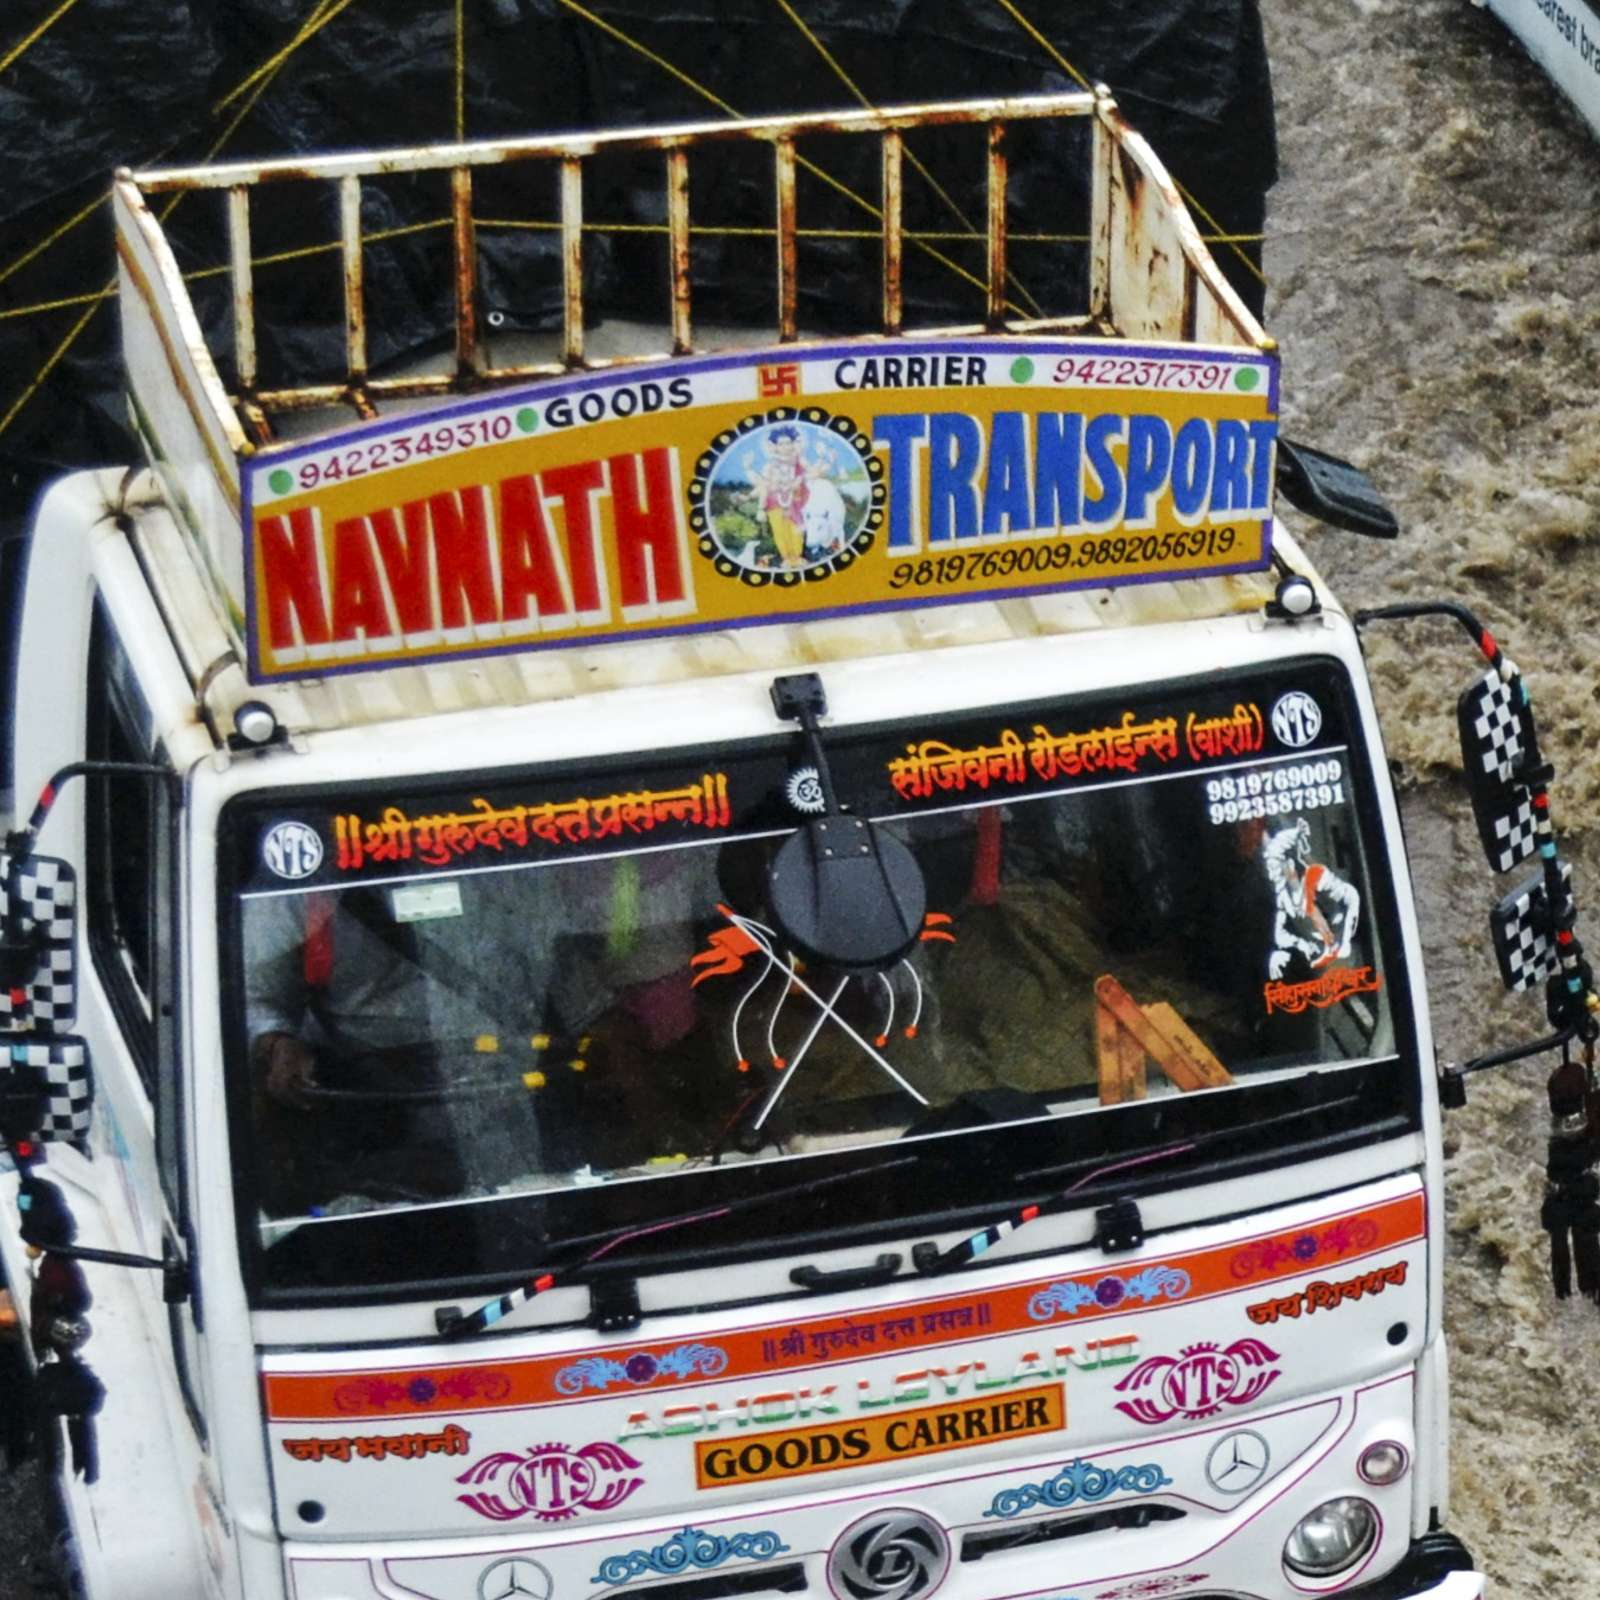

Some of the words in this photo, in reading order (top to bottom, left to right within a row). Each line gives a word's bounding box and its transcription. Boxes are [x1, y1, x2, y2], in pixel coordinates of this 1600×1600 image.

[299, 415, 513, 490] 9422349310
[544, 377, 694, 429] GOODS
[834, 356, 987, 390] CARRIER
[1052, 358, 1232, 391] 9422317391
[258, 446, 696, 666] NAVNATH
[872, 411, 1278, 556] TRANSPORT
[1273, 693, 1321, 745] NTS
[1206, 759, 1342, 802] 9819769009
[1209, 782, 1346, 825] 9923587391
[265, 824, 323, 877] NTS
[617, 1383, 841, 1444] ASHOK
[857, 1333, 1141, 1410] LEYLAND
[1164, 1353, 1240, 1410] NTS
[703, 1428, 872, 1481] GOODS
[885, 1395, 1052, 1450] CARRIER
[510, 1456, 596, 1511] NTS
